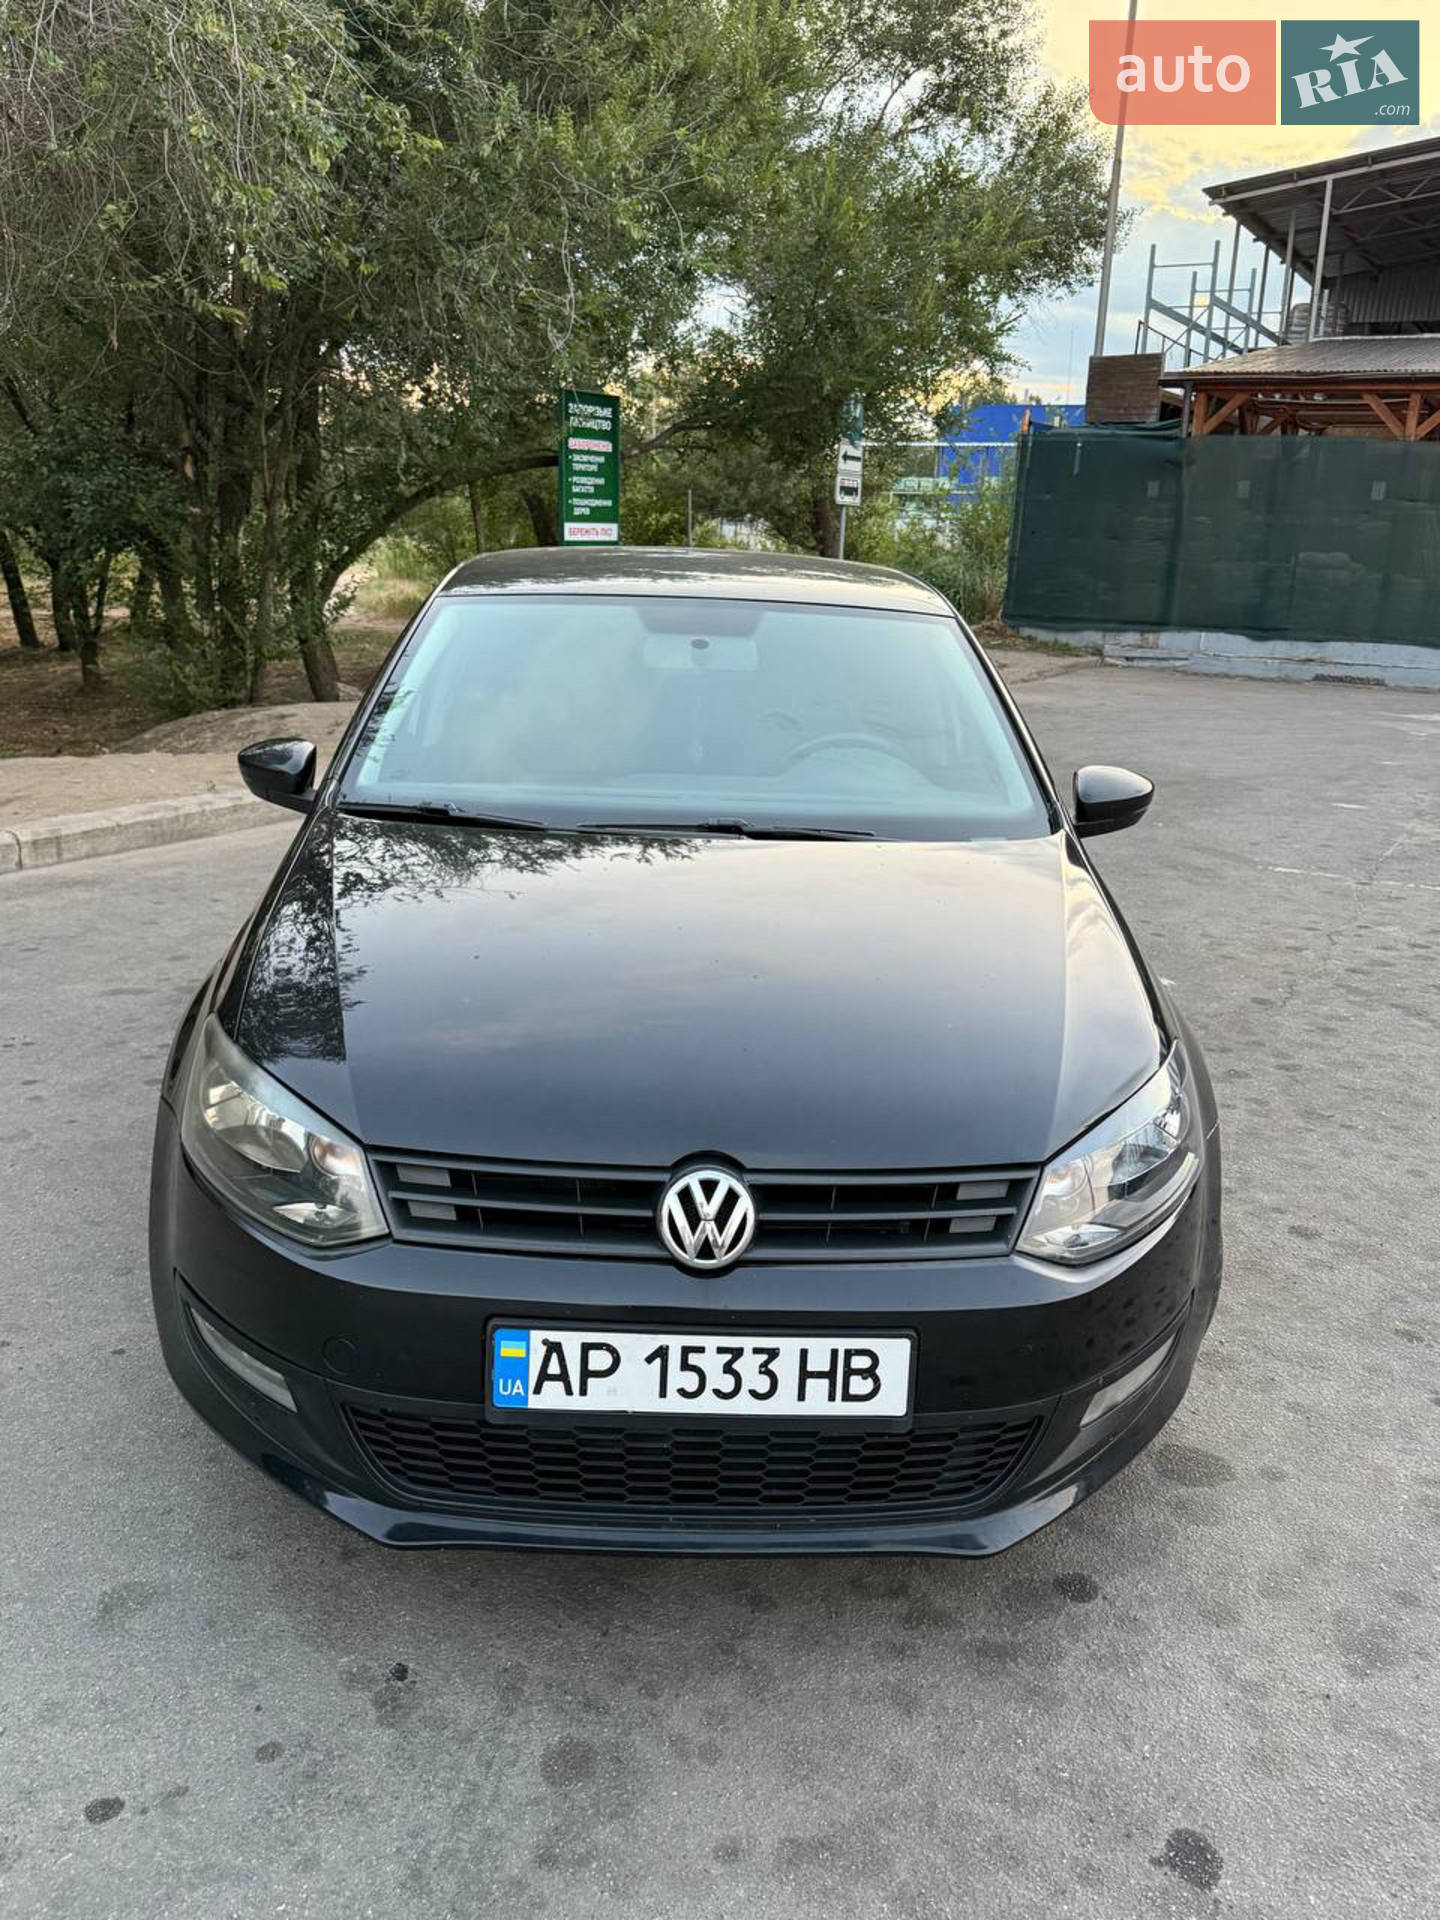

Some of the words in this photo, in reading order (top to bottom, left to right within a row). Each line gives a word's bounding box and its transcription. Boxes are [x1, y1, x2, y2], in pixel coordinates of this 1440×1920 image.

[499, 1379, 525, 1397] UA
[532, 1338, 622, 1397] AP
[644, 1344, 780, 1401] 1533
[797, 1348, 882, 1402] HB
